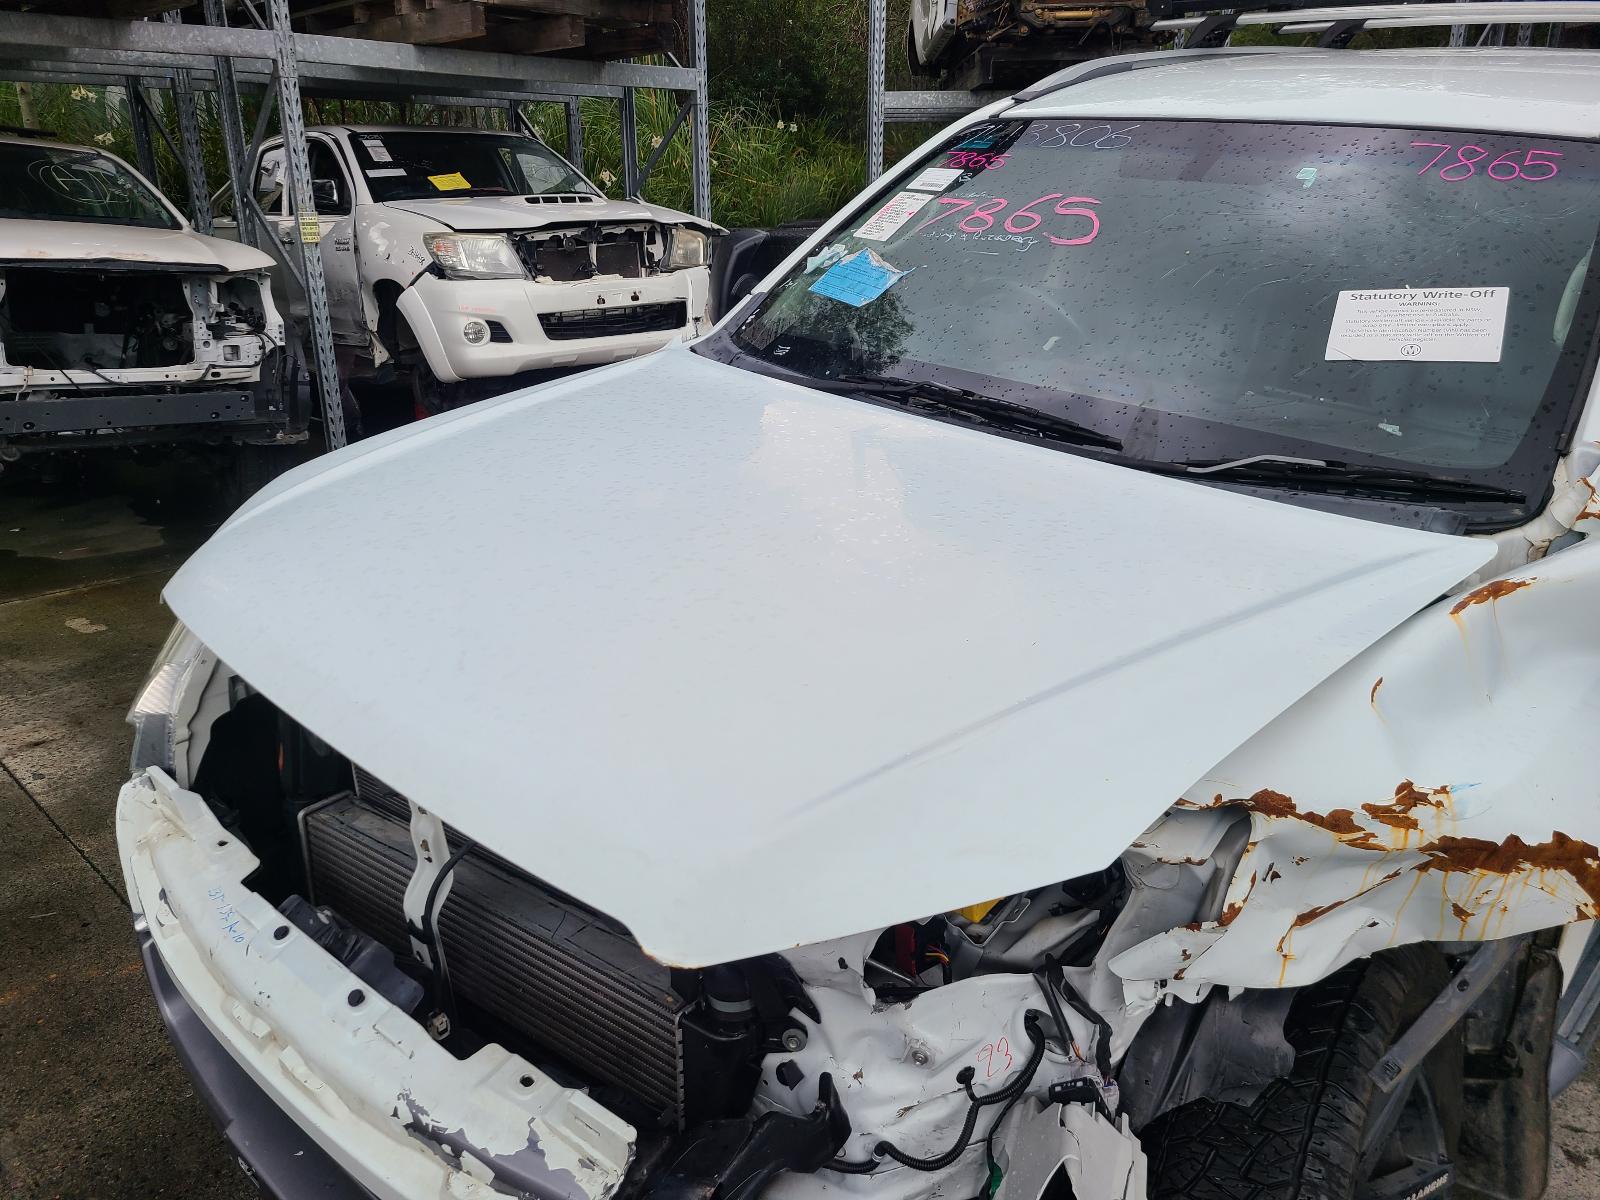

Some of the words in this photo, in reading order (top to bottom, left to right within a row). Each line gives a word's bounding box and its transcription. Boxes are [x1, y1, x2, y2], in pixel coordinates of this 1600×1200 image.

[939, 151, 1012, 170] 7865
[1410, 141, 1563, 182] 7865
[917, 193, 1102, 246] 7865
[1350, 292, 1418, 301] Statutory
[1423, 289, 1496, 299] Write-Off
